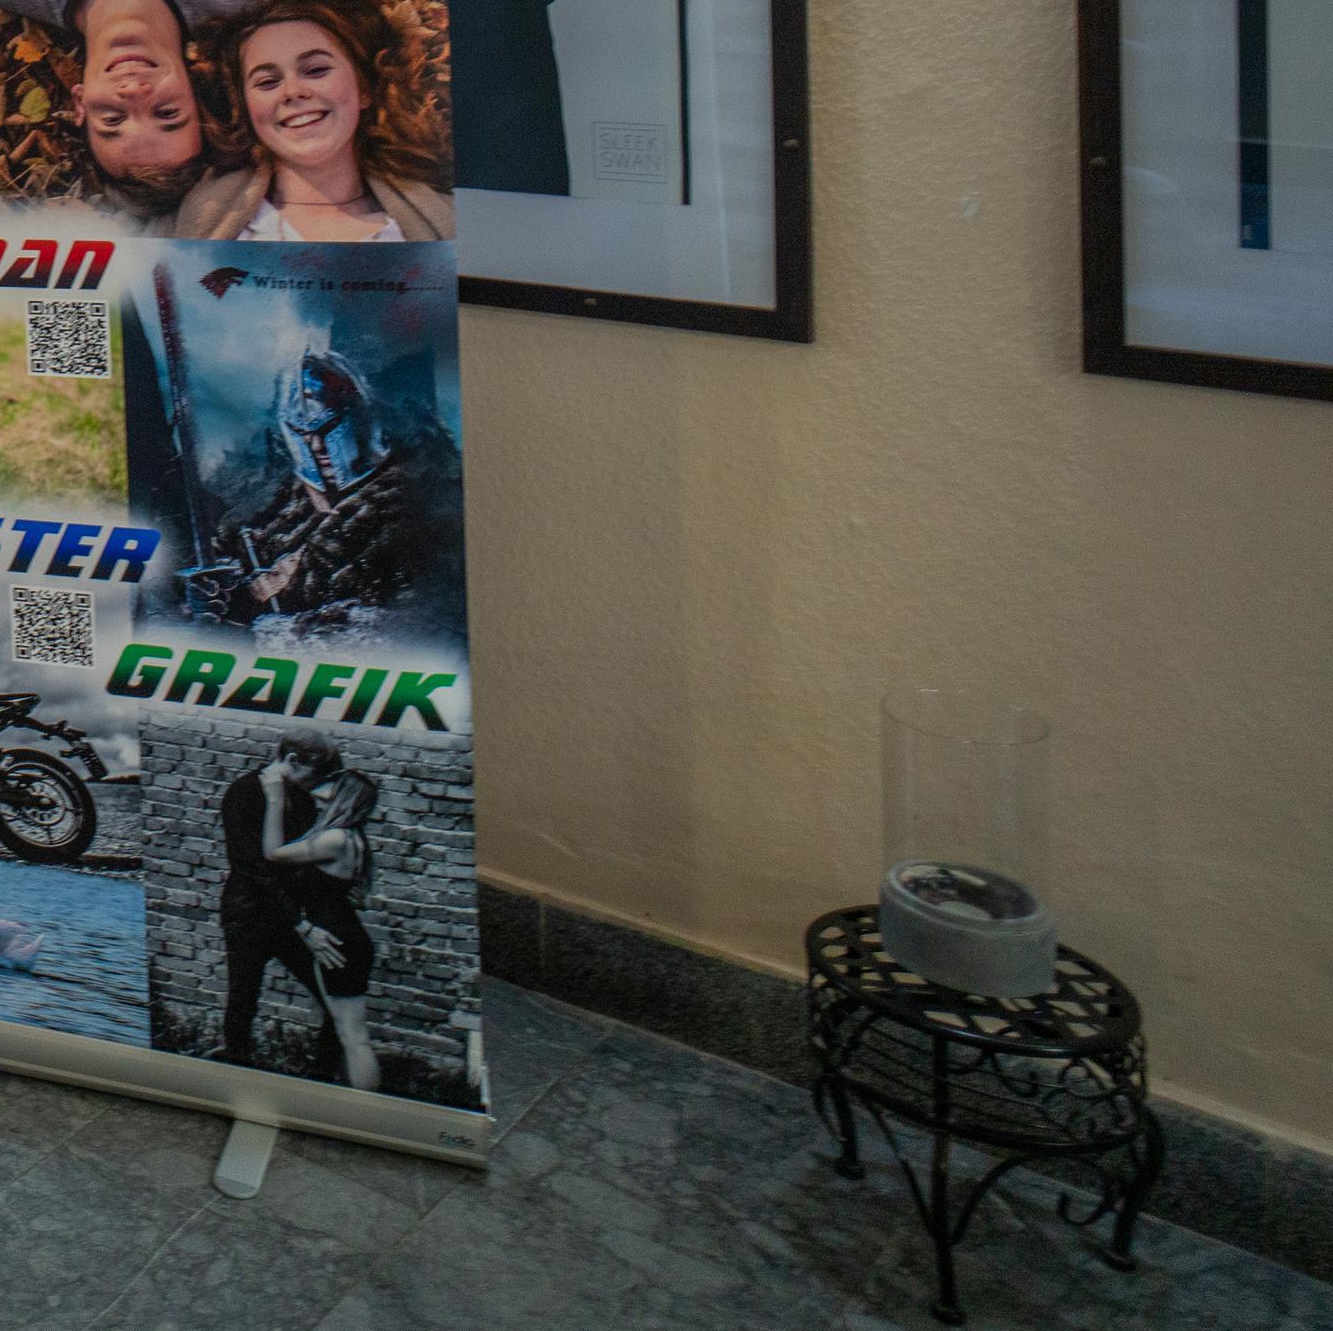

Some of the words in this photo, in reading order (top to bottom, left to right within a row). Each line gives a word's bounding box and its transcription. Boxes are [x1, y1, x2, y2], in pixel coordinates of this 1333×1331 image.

[252, 274, 313, 291] Winter
[319, 276, 334, 291] is
[105, 642, 458, 733] GRAFIK
